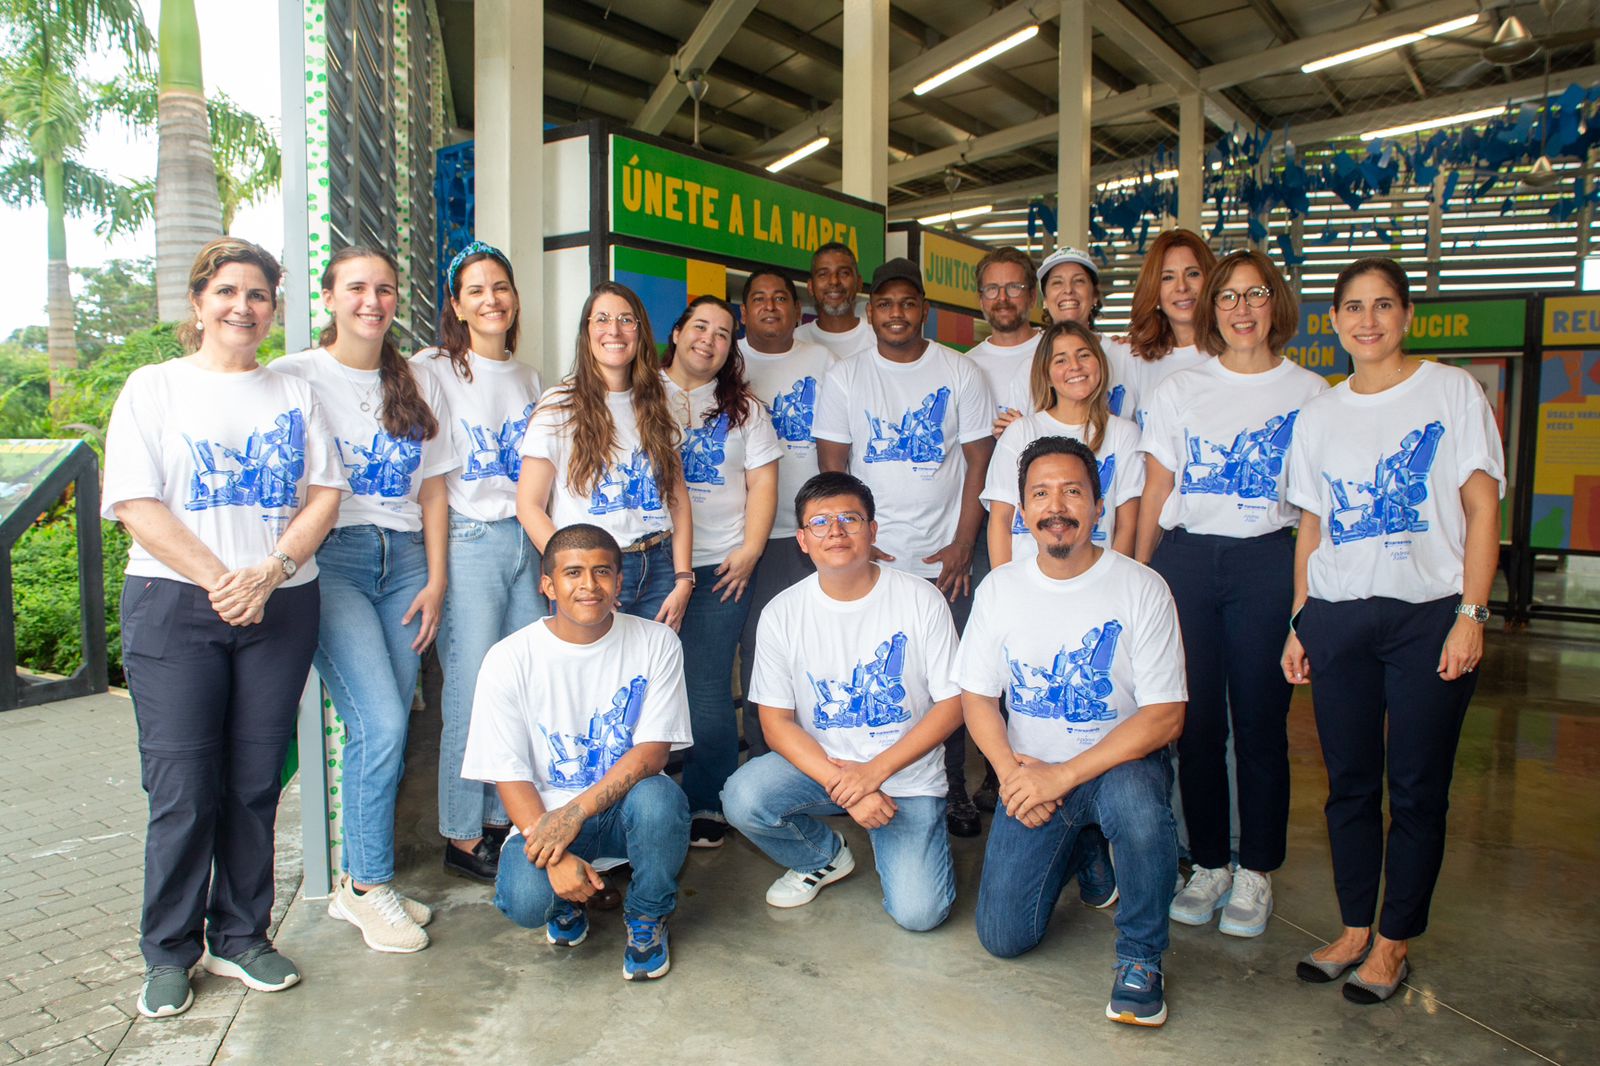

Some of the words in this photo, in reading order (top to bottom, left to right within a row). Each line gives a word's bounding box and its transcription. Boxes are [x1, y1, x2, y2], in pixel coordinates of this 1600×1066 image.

[622, 155, 718, 229] ÚNETE
[728, 194, 744, 235] A
[753, 199, 783, 245] LA
